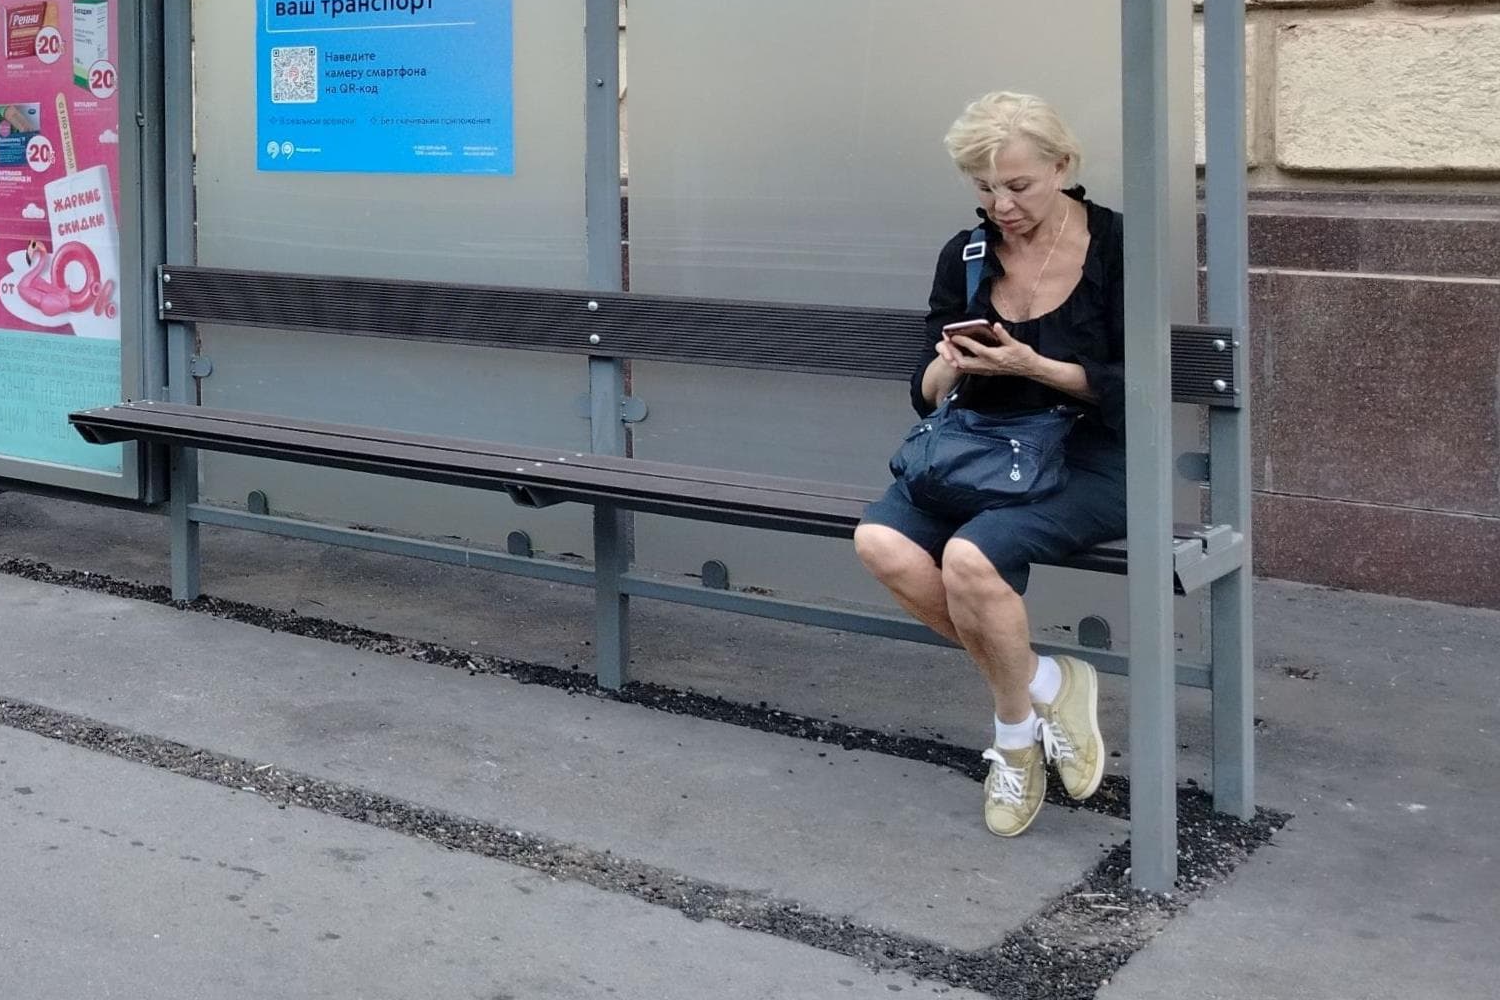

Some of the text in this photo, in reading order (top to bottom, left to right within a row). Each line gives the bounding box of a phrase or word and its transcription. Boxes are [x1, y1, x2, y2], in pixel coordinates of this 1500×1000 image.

[275, 0, 315, 16] ваш
[12, 14, 40, 26] Ренни
[324, 51, 377, 63] Наведите
[325, 65, 427, 80] камеру смартфона
[325, 83, 379, 95] на QR-код
[53, 188, 102, 213] ЖАРКИЕ
[57, 213, 106, 236] СКИДКИ
